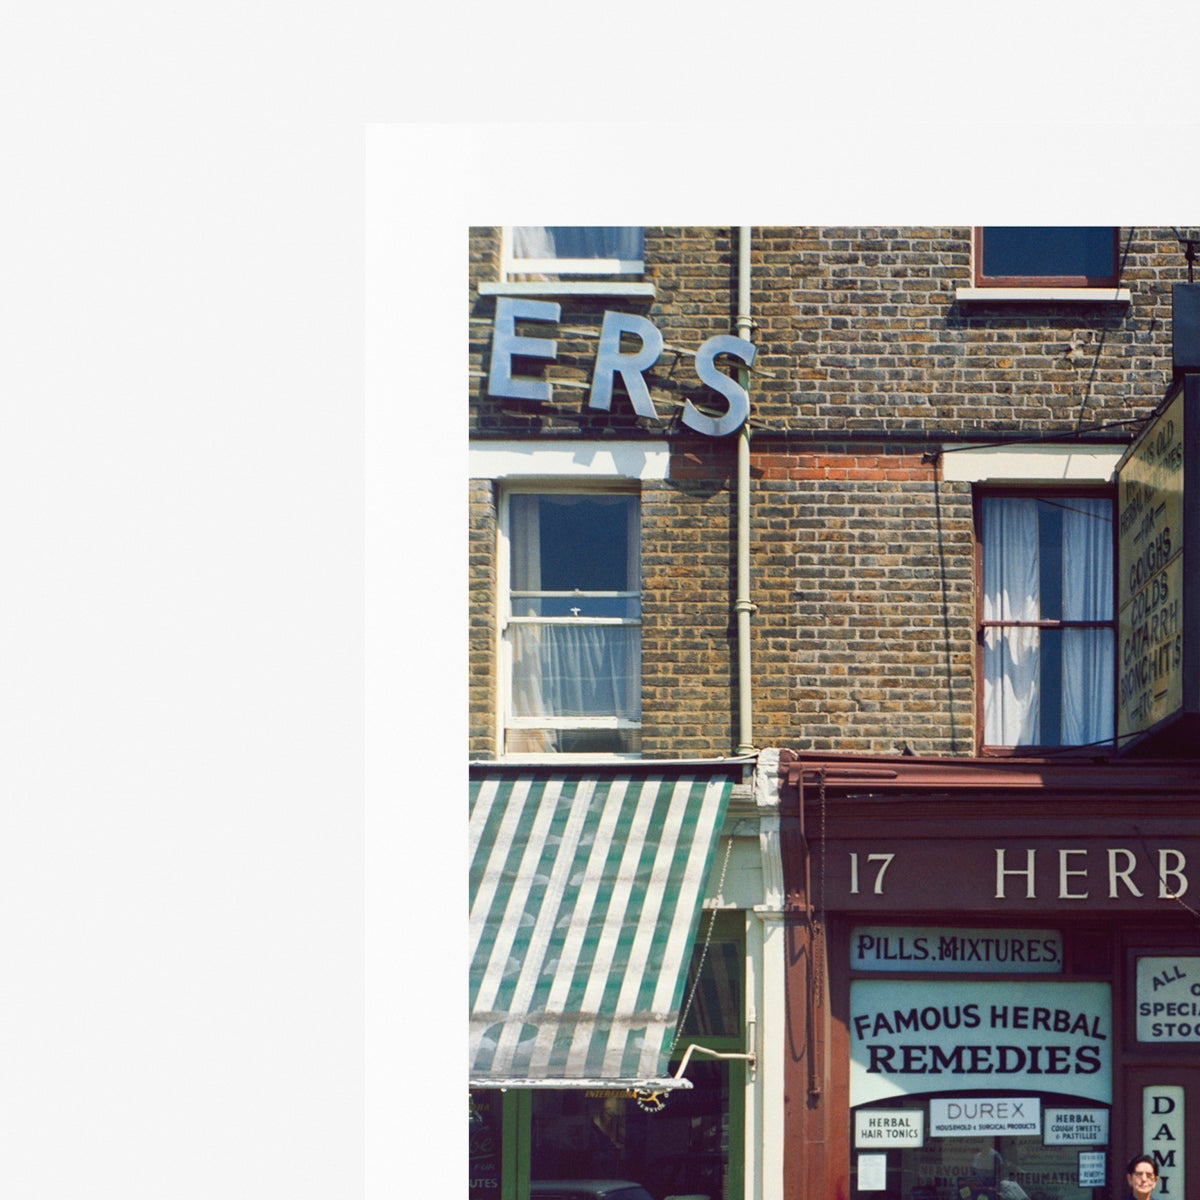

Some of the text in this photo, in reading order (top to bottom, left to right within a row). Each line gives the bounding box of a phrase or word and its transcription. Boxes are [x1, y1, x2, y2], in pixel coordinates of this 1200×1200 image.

[488, 297, 757, 437] ERS
[1157, 420, 1174, 456] OLD
[1131, 571, 1169, 626] COLDS
[1124, 600, 1178, 666] CATARRH
[849, 853, 895, 894] 17
[1152, 966, 1187, 991] ALL
[853, 1004, 1107, 1040] FAMOUS HERBAL
[866, 1045, 1101, 1074] REMEDIES
[869, 1118, 910, 1127] HERBAL
[948, 1103, 1024, 1119] DUREX
[1056, 1115, 1095, 1123] HERBAL
[861, 1129, 918, 1138] HAIR TONICS
[1008, 1172, 1077, 1184] RHEUMATIS
